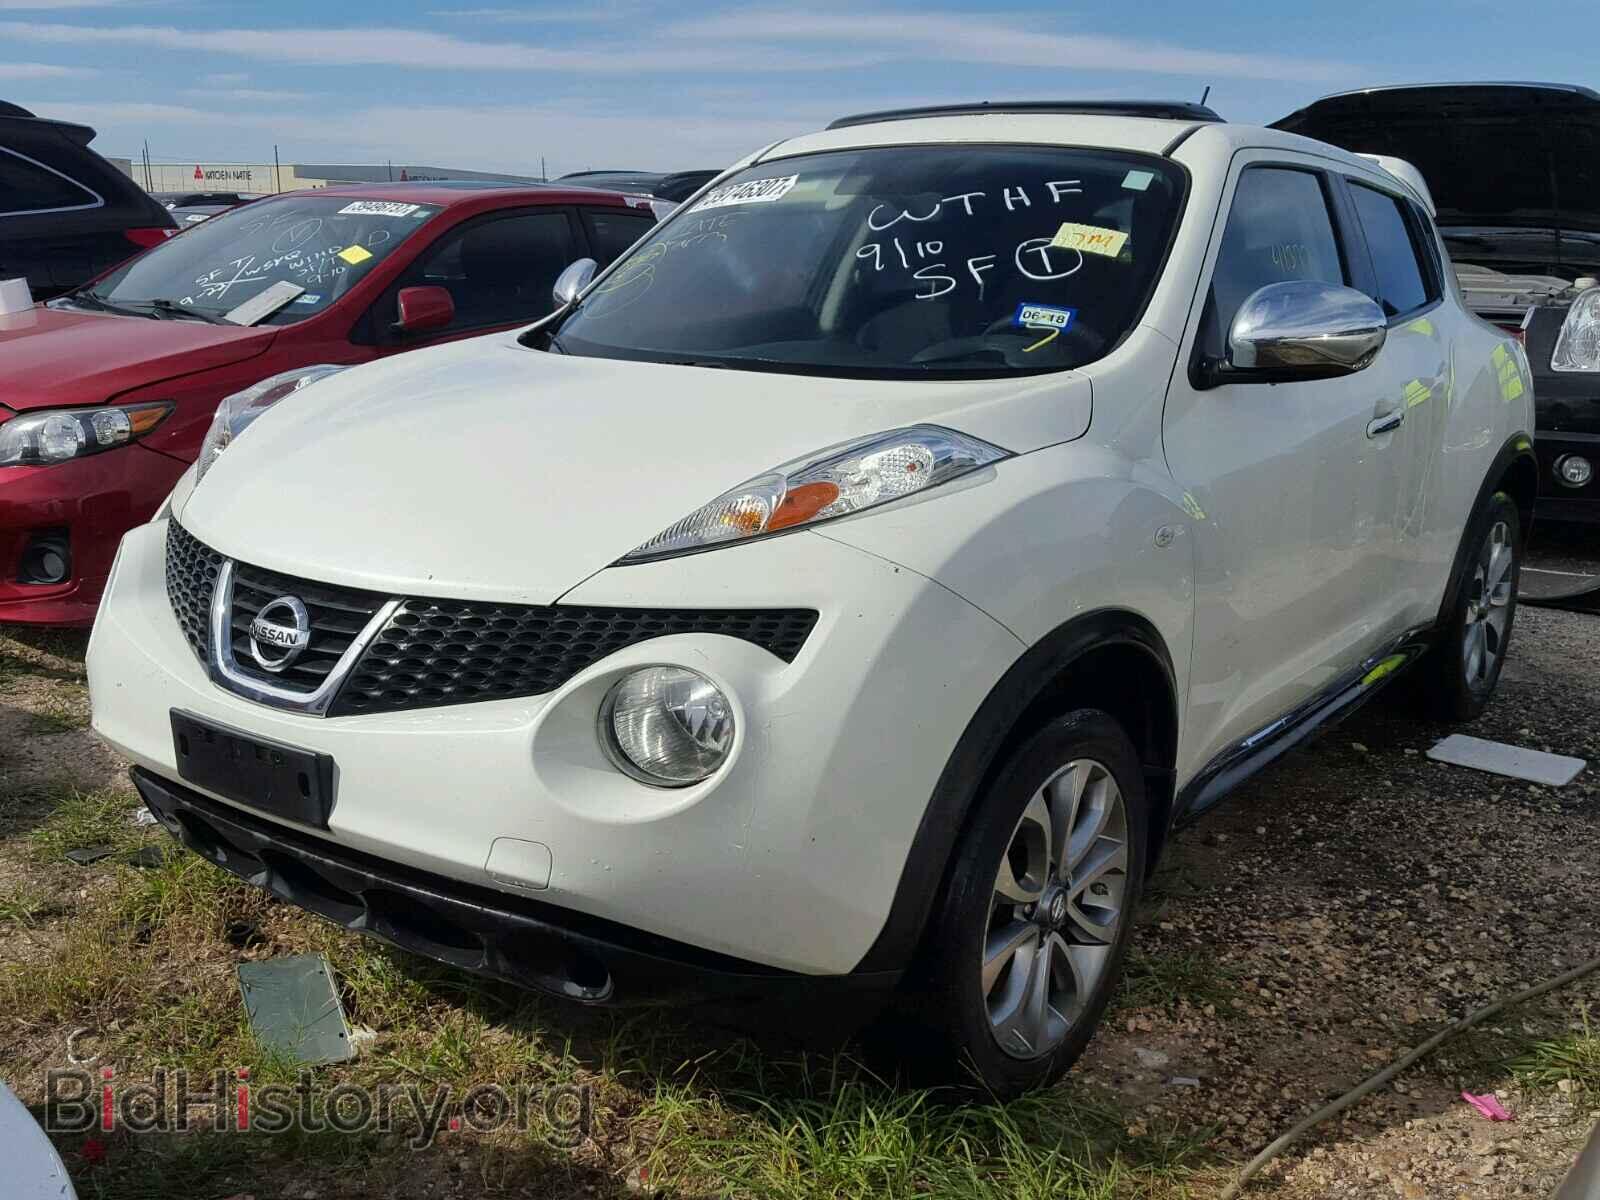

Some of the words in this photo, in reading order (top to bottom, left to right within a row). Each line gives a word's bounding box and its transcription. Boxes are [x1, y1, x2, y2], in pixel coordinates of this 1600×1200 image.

[913, 254, 997, 299] SF
[1023, 310, 1066, 324] 06-18
[251, 621, 298, 645] NISSAN
